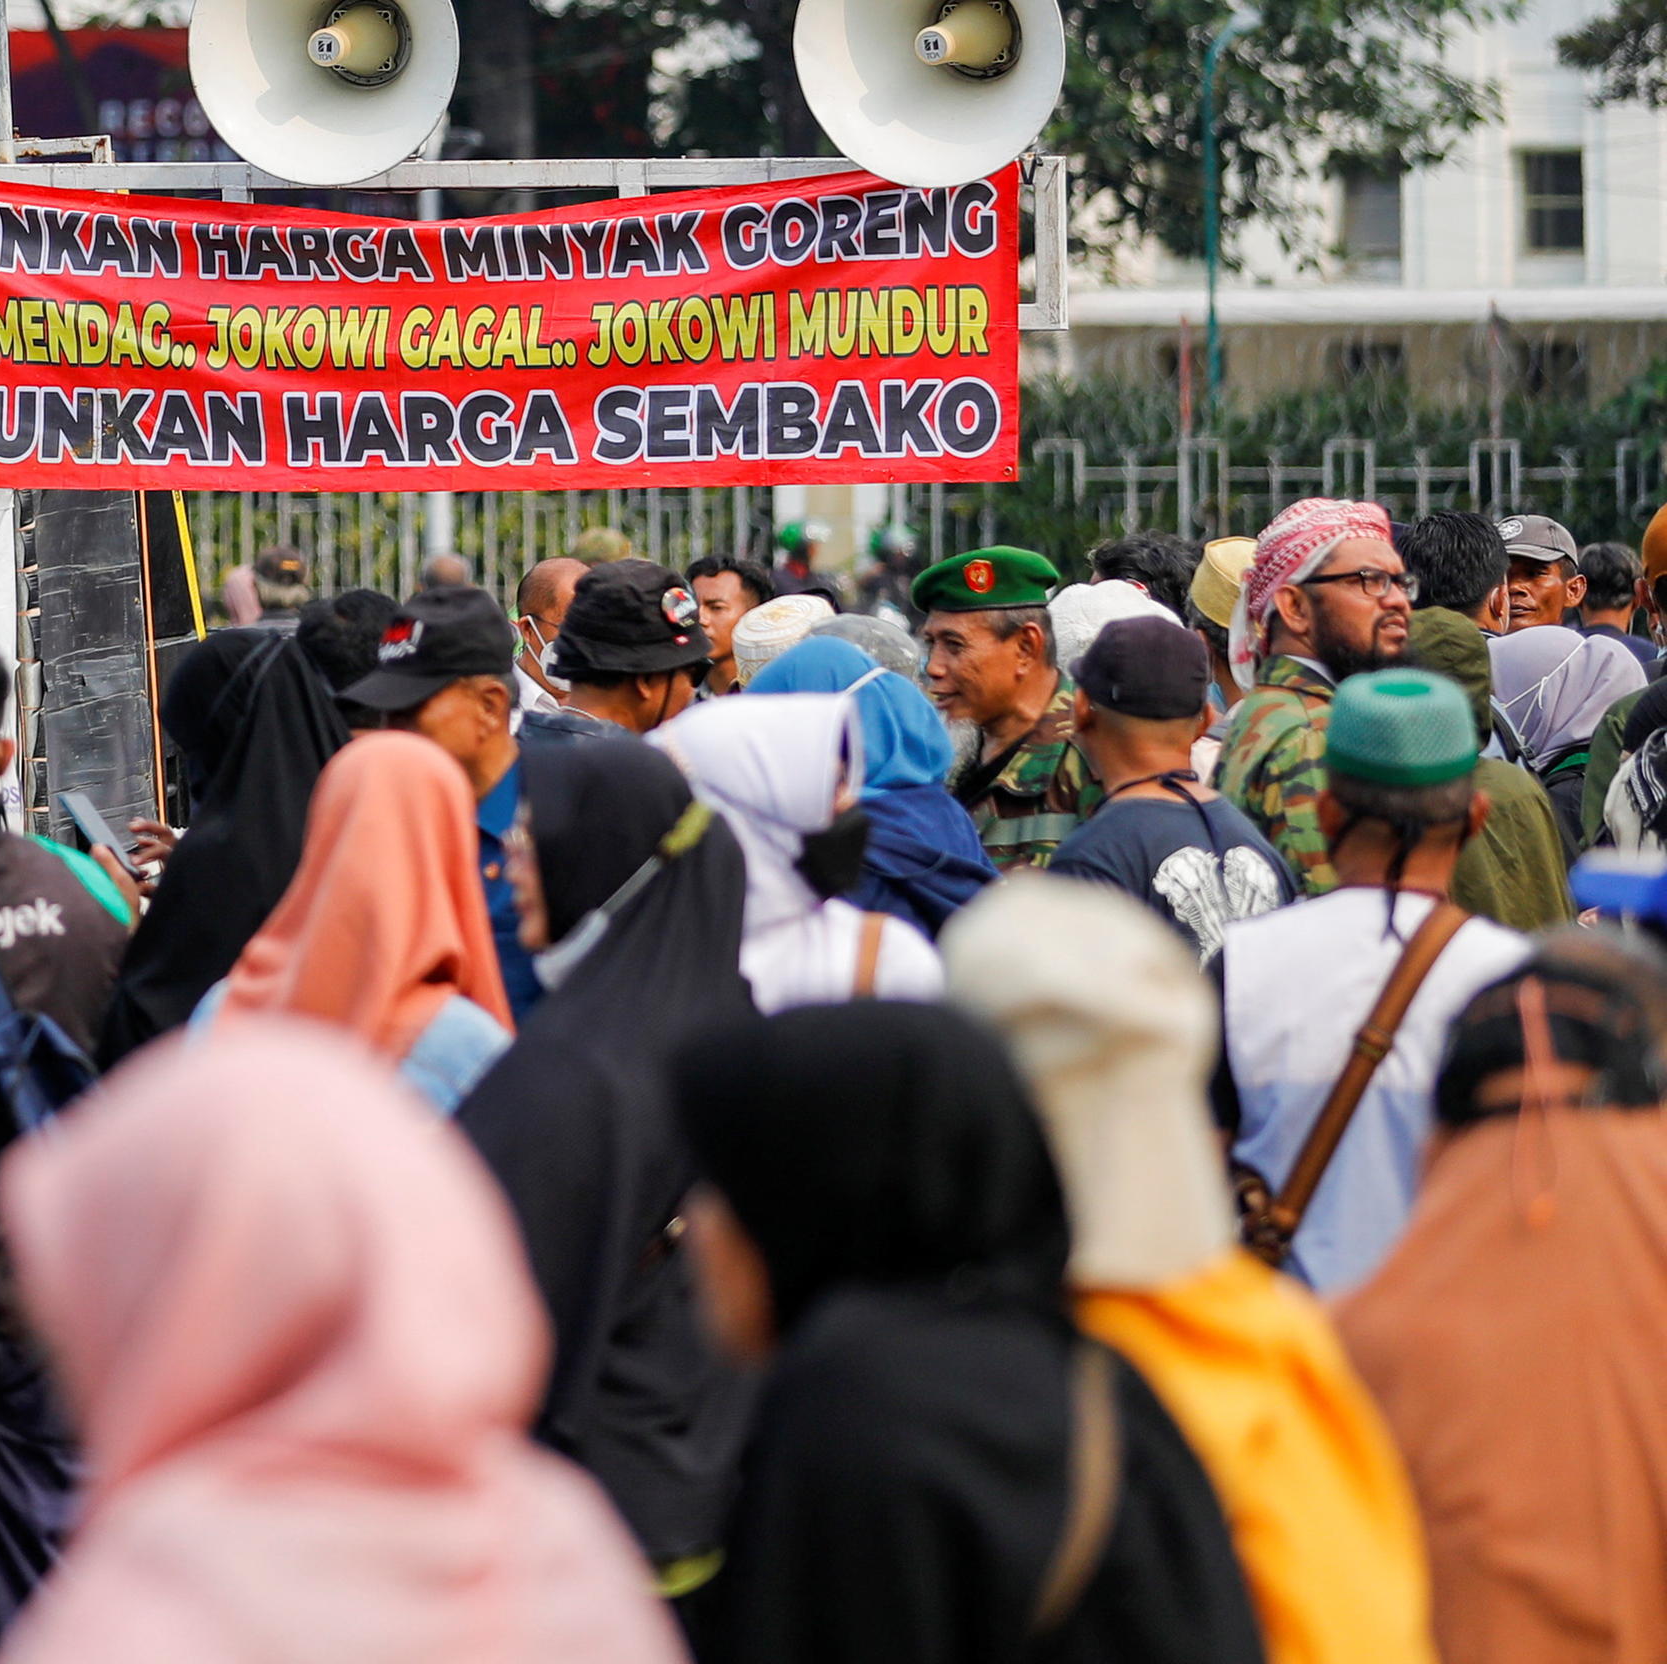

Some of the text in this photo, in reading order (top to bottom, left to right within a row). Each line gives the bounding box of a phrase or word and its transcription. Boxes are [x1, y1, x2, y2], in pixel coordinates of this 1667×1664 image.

[197, 222, 434, 283] HARGA
[442, 209, 710, 283] MINYAK
[722, 180, 999, 271] GORENG
[205, 303, 391, 371] JOKOWI
[399, 304, 577, 370] GAGAL..
[587, 291, 777, 368] JOKOWI
[788, 283, 990, 359] MUNDUR
[284, 388, 579, 468] HARGA
[592, 376, 1002, 464] SEMBAKO
